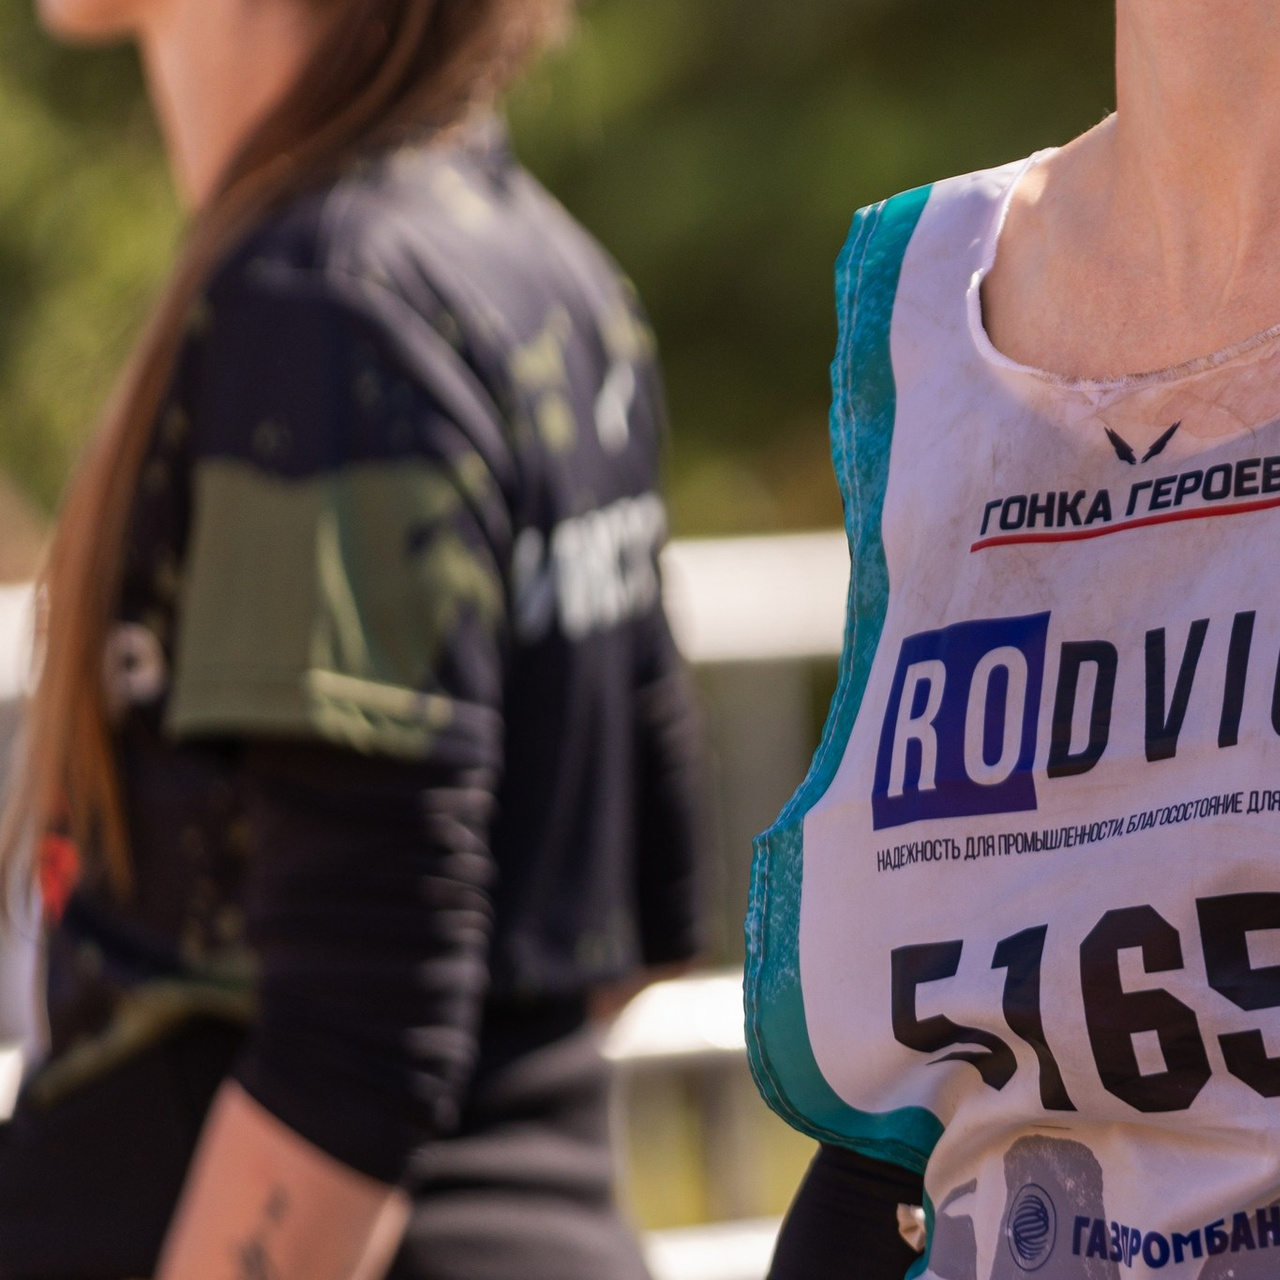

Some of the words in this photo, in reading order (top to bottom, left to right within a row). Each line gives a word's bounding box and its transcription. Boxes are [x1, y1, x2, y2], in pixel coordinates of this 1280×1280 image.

[979, 488, 1113, 536] ГОНКА
[876, 837, 961, 872] НАДЕЖНОСТЬ
[964, 834, 996, 862] ДЛЯ
[997, 818, 1125, 856] ПРОМЫШЛЕННОСТИ,
[1126, 791, 1244, 834] БЛАГОСОСТОЯНИЕ
